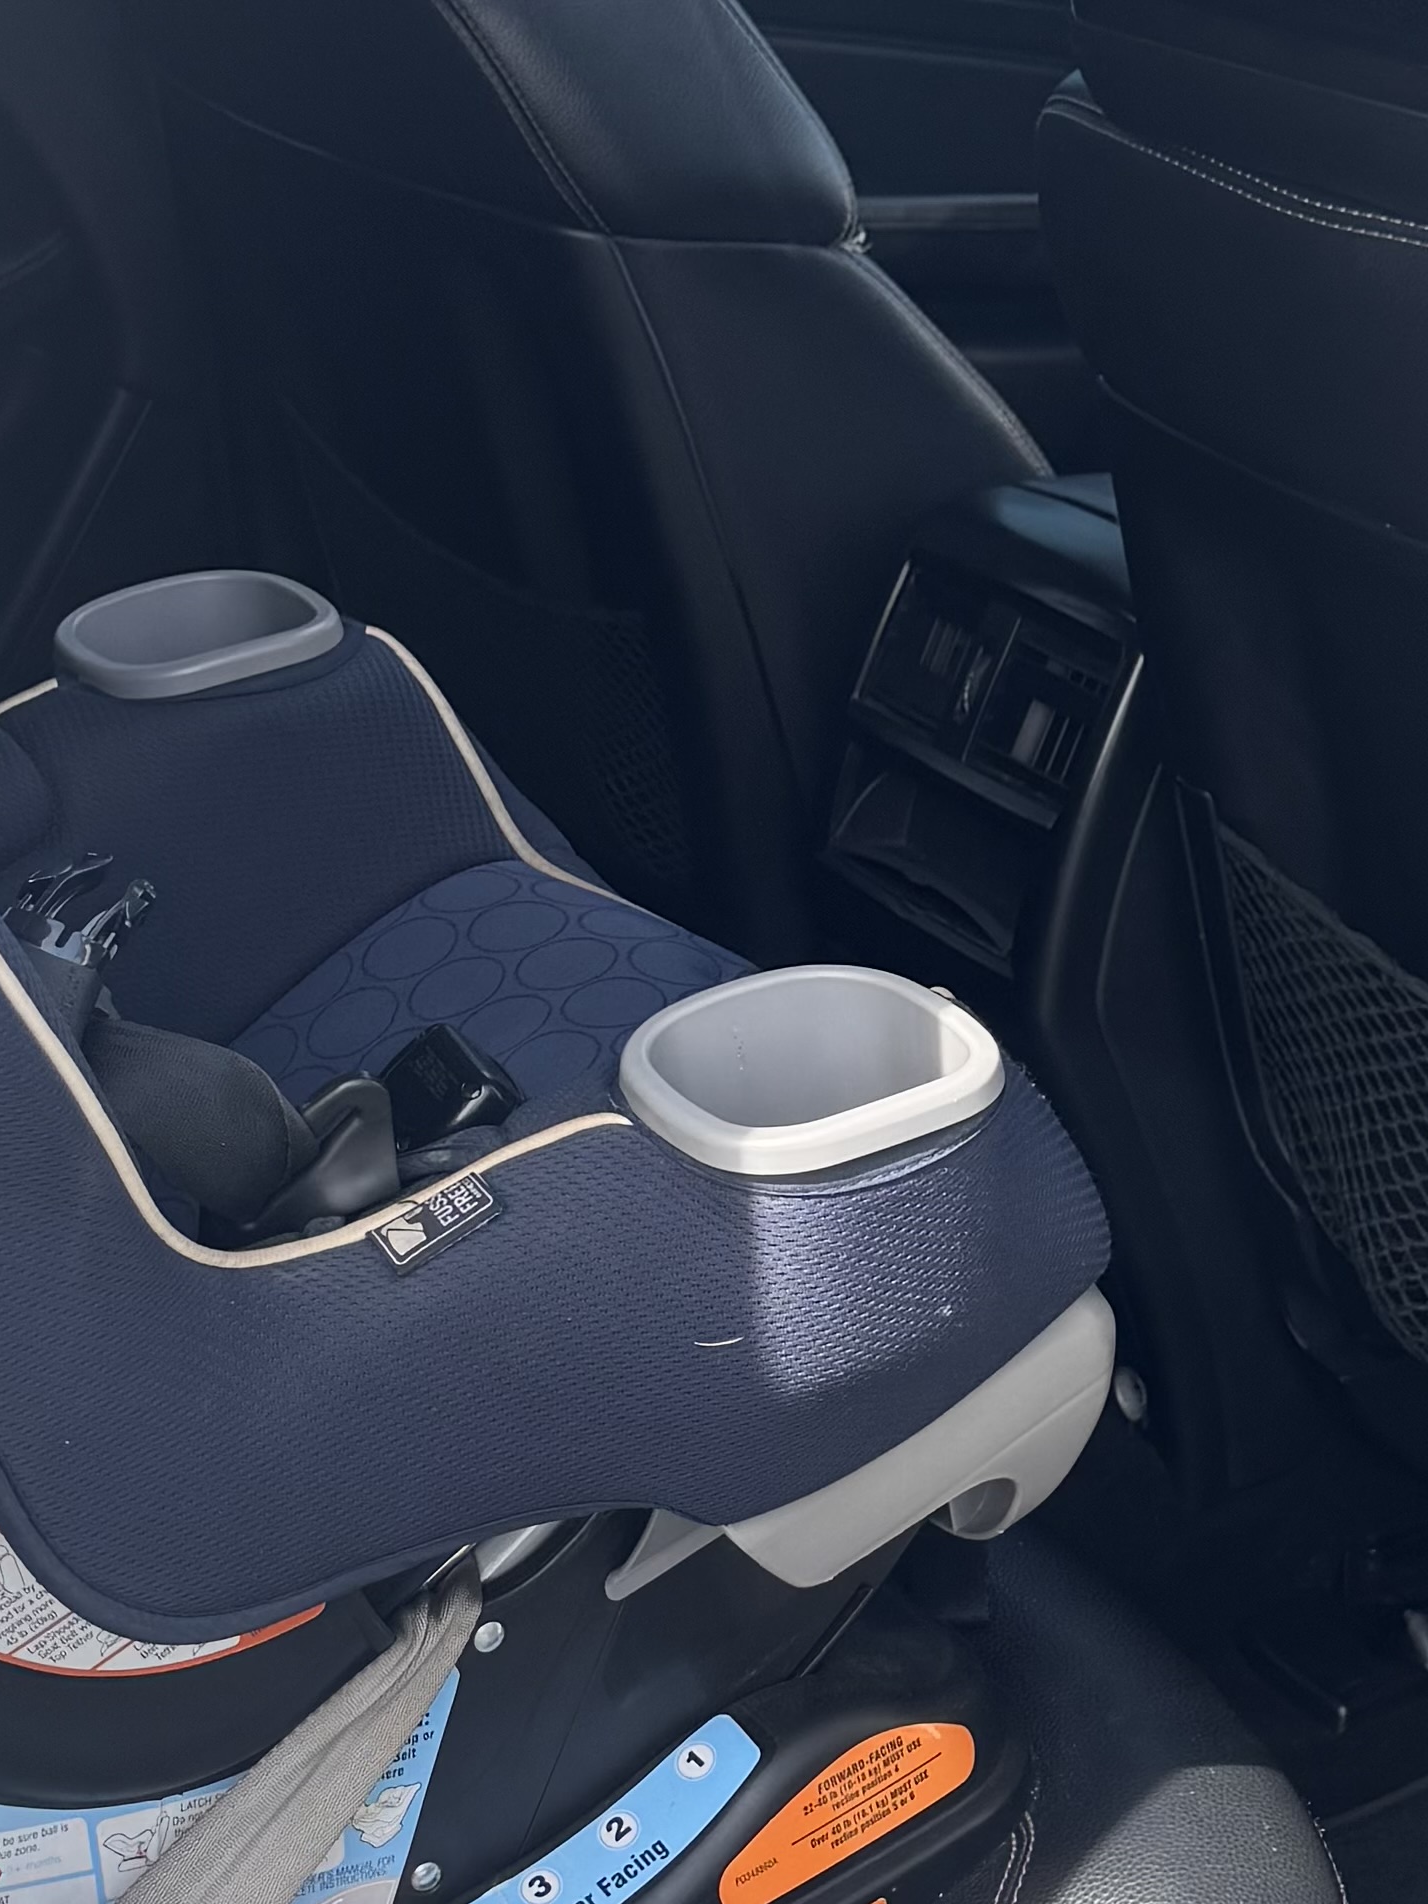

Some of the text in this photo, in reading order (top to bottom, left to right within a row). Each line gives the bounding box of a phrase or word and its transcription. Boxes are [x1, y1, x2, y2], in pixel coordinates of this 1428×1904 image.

[688, 1752, 704, 1767] 1
[816, 1734, 904, 1794] FORWARD-FACING
[180, 1796, 211, 1813] LATCH
[2, 1835, 14, 1848] be
[17, 1830, 38, 1843] sure
[41, 1824, 58, 1838] ball
[61, 1822, 68, 1832] is
[608, 1817, 631, 1840] 2
[597, 1840, 671, 1897] Facing
[530, 1876, 552, 1897] 3
